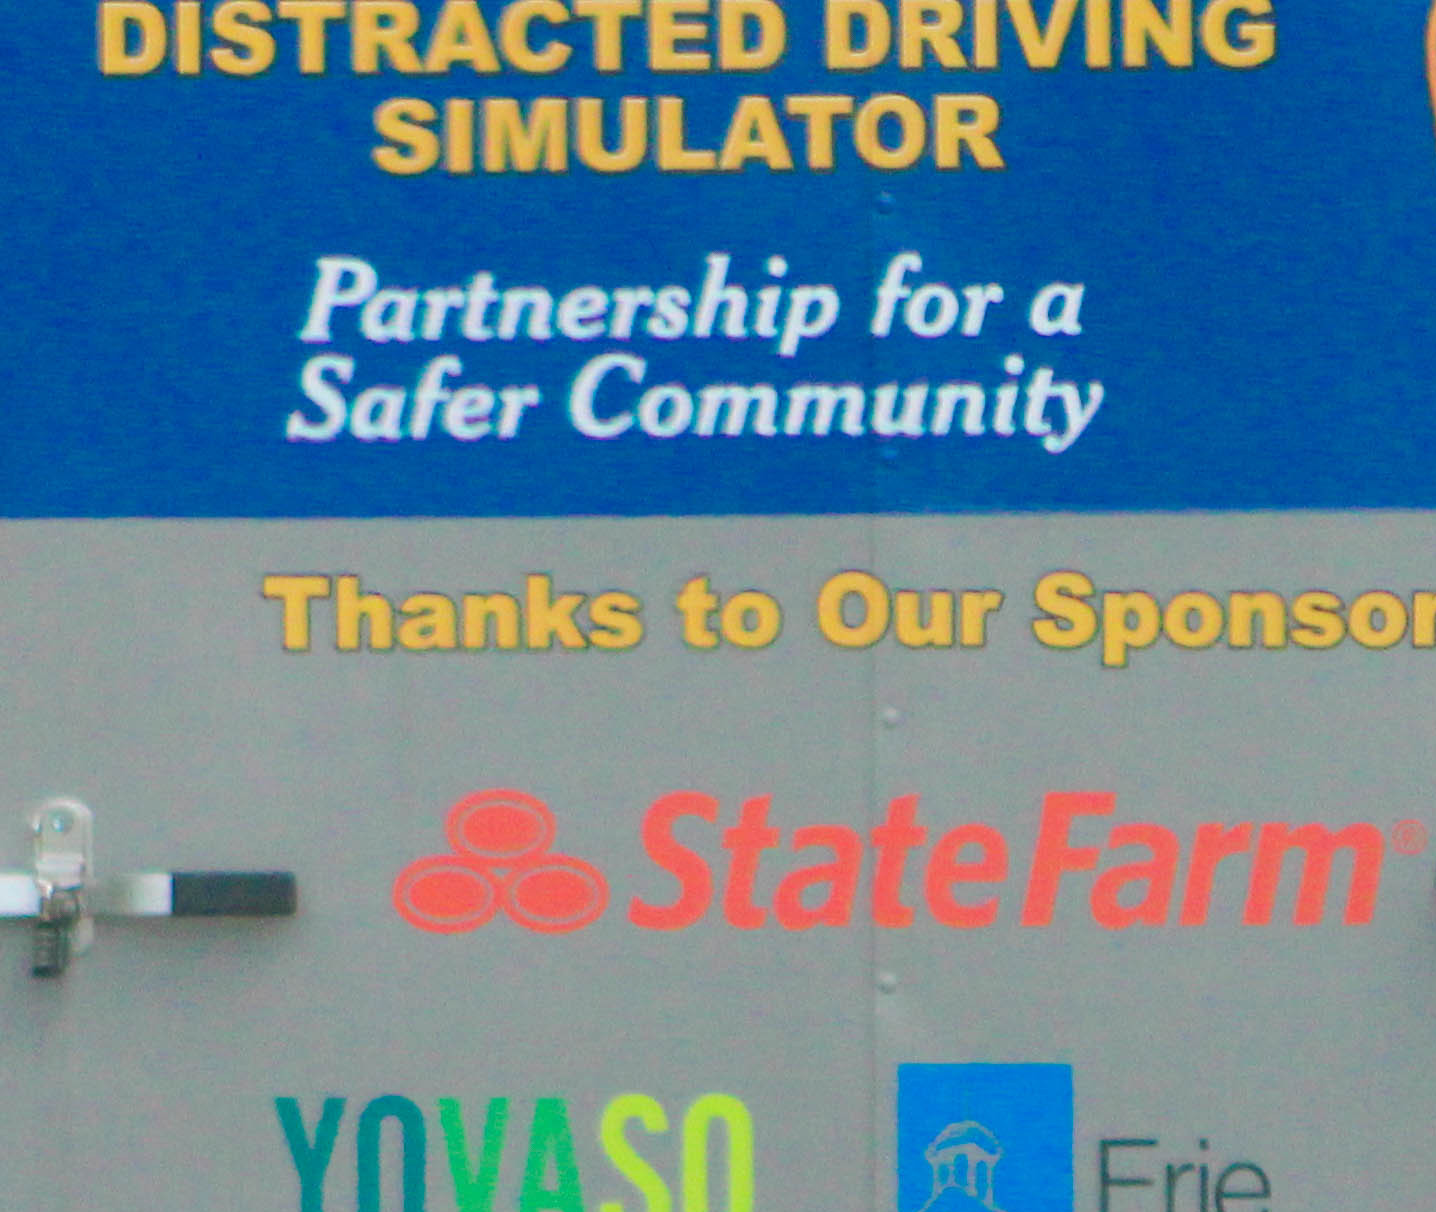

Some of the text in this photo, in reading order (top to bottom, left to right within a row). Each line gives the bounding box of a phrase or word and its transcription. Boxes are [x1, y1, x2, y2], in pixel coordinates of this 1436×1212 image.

[100, 0, 1276, 76] DISTRACTED DRIVING
[371, 93, 1006, 175] SIMULATOR
[298, 250, 1087, 359] Partnership for a
[286, 351, 1106, 455] Safer Community
[262, 575, 646, 652] Thanks
[677, 578, 783, 650] to
[816, 572, 1002, 652] Our
